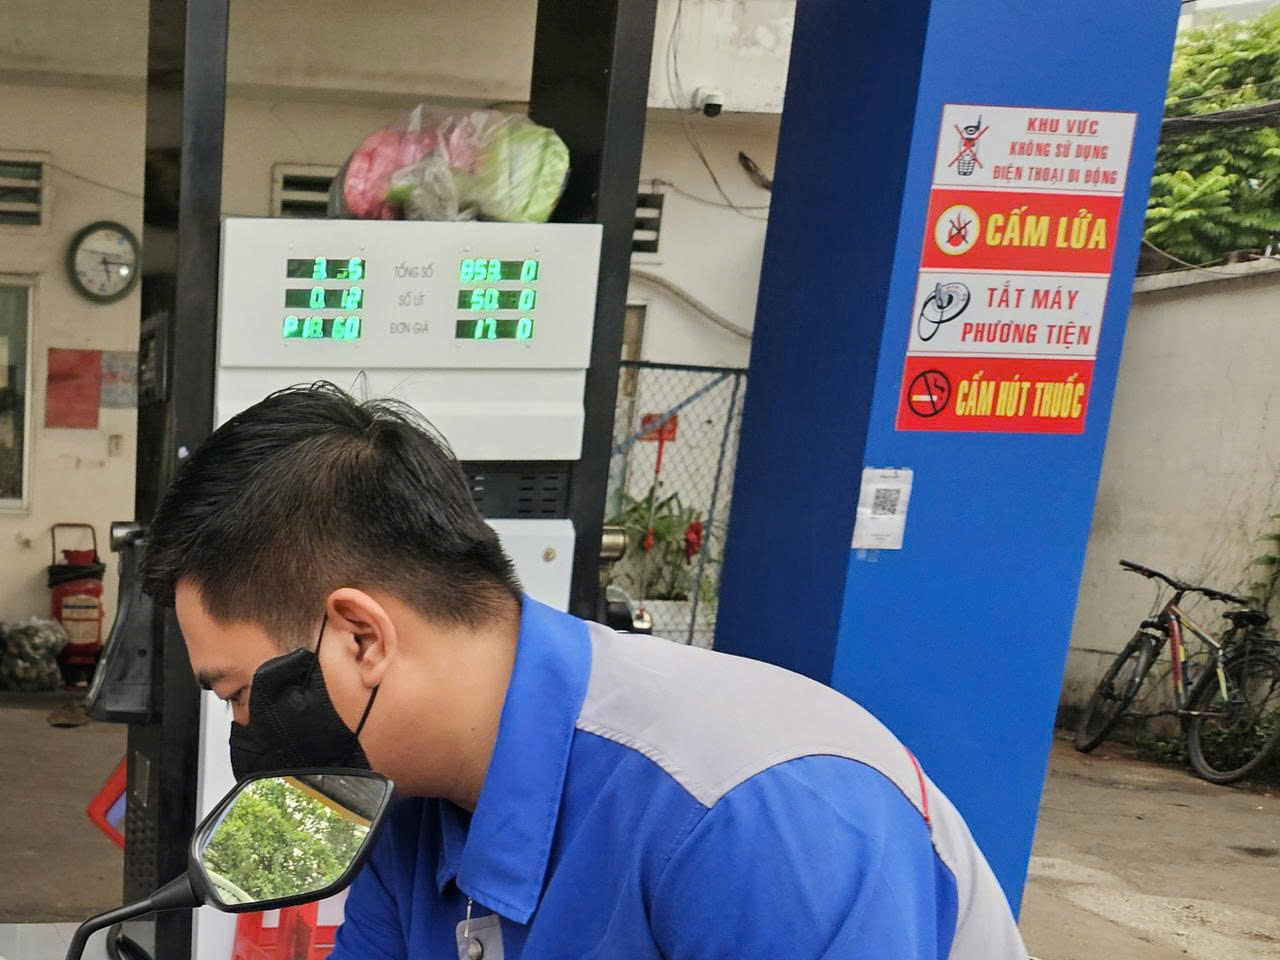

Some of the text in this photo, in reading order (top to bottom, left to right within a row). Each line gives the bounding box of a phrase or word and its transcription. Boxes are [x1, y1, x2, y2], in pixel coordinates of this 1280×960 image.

[1027, 117, 1099, 136] KHU VỰC
[1009, 139, 1051, 157] KHÔNG
[1074, 145, 1109, 162] DỤNG
[992, 164, 1118, 188] ĐIỆN THOẠI DI ĐỘNG
[985, 206, 1107, 250] CẤM LỬA
[987, 280, 1079, 310] TẮT MÁY
[961, 320, 1093, 349] PHƯƠNG TIỆN
[955, 370, 1085, 418] CẤM HÚT THUỐC
